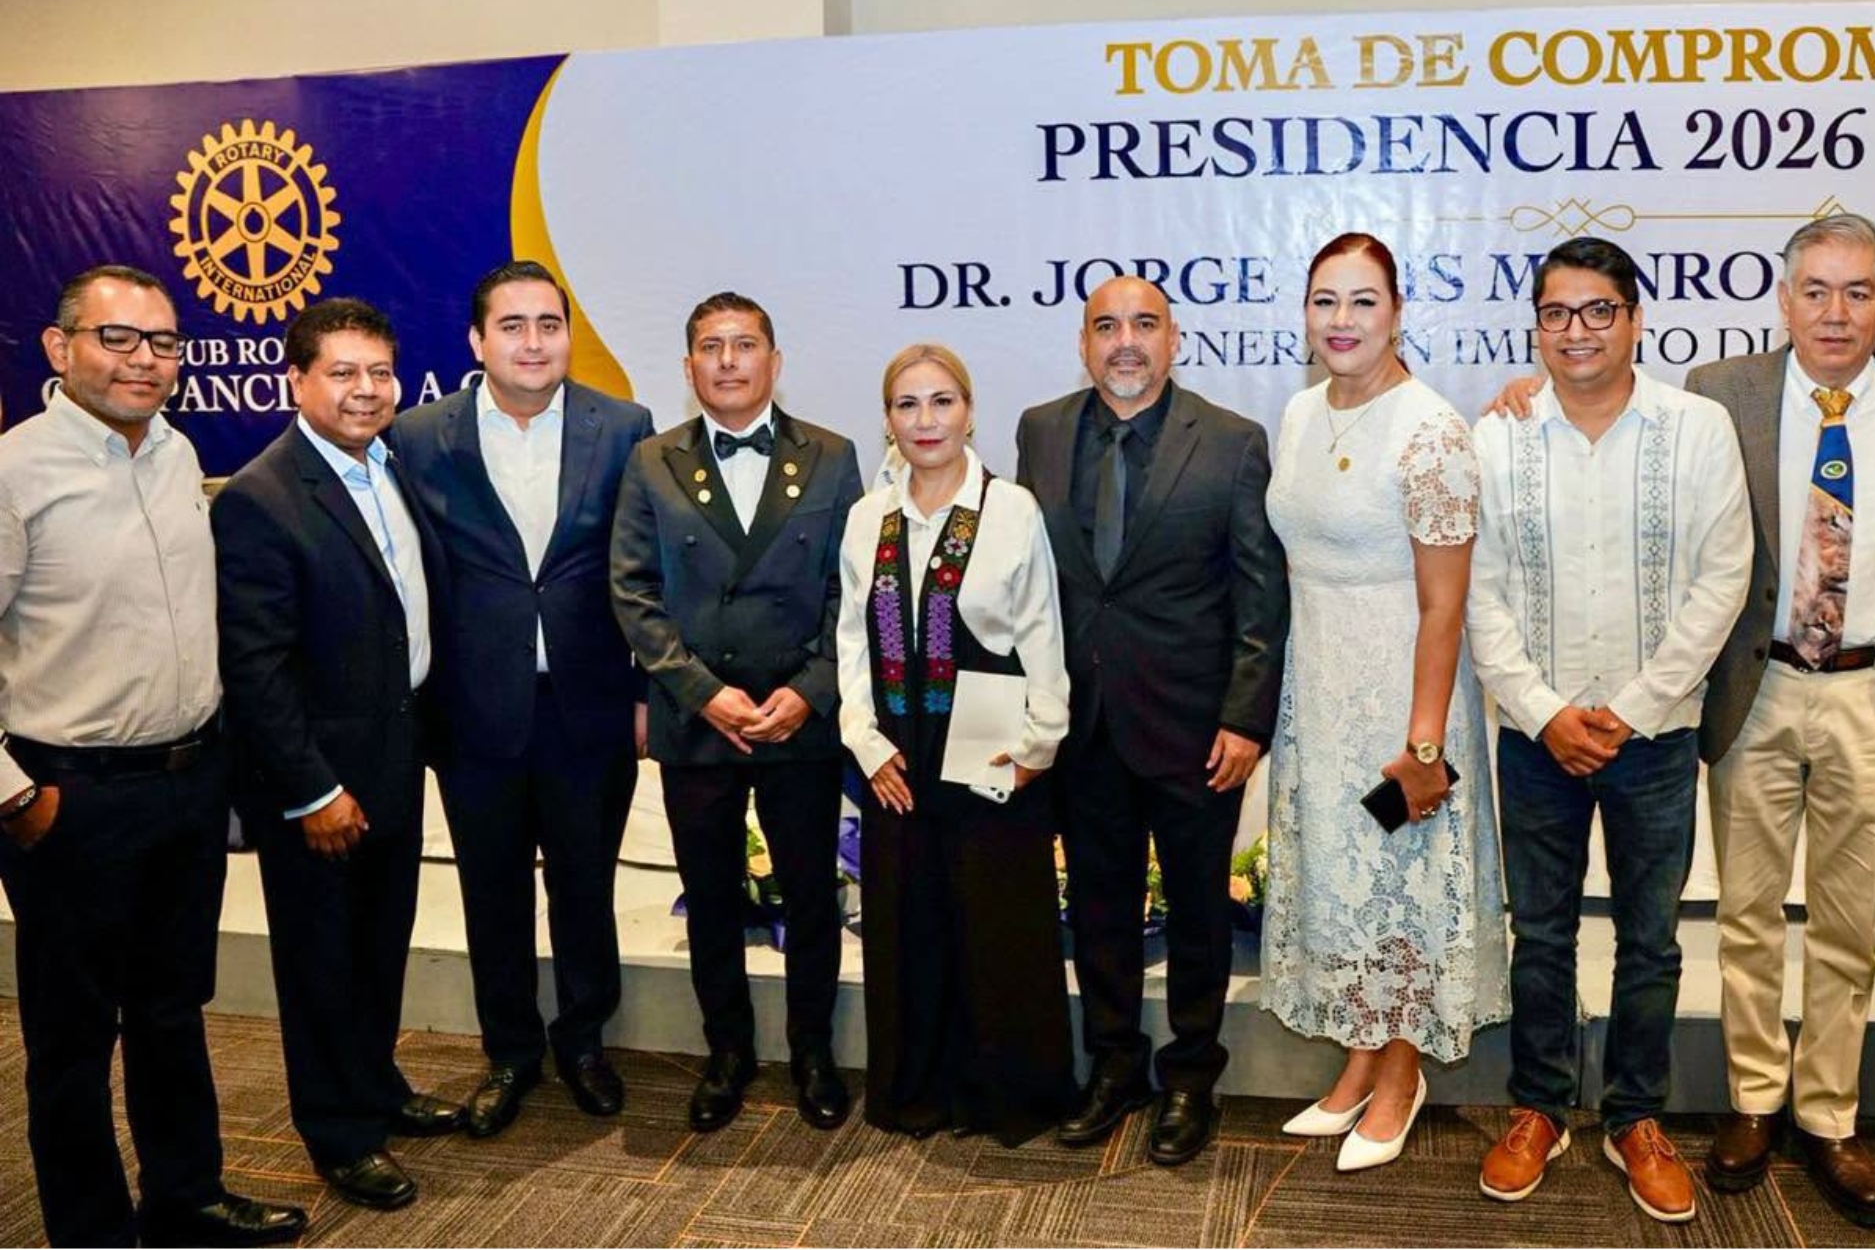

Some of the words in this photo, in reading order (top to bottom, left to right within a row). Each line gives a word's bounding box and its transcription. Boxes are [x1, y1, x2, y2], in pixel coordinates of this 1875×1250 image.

[1106, 38, 1336, 96] TOMA
[1354, 32, 1471, 89] DE
[214, 142, 286, 169] ROTARY
[1036, 109, 1659, 182] PRESIDENCIA
[1684, 108, 1868, 171] 2026
[199, 251, 316, 301] INTERNATIONAL
[898, 261, 1011, 310] DR.
